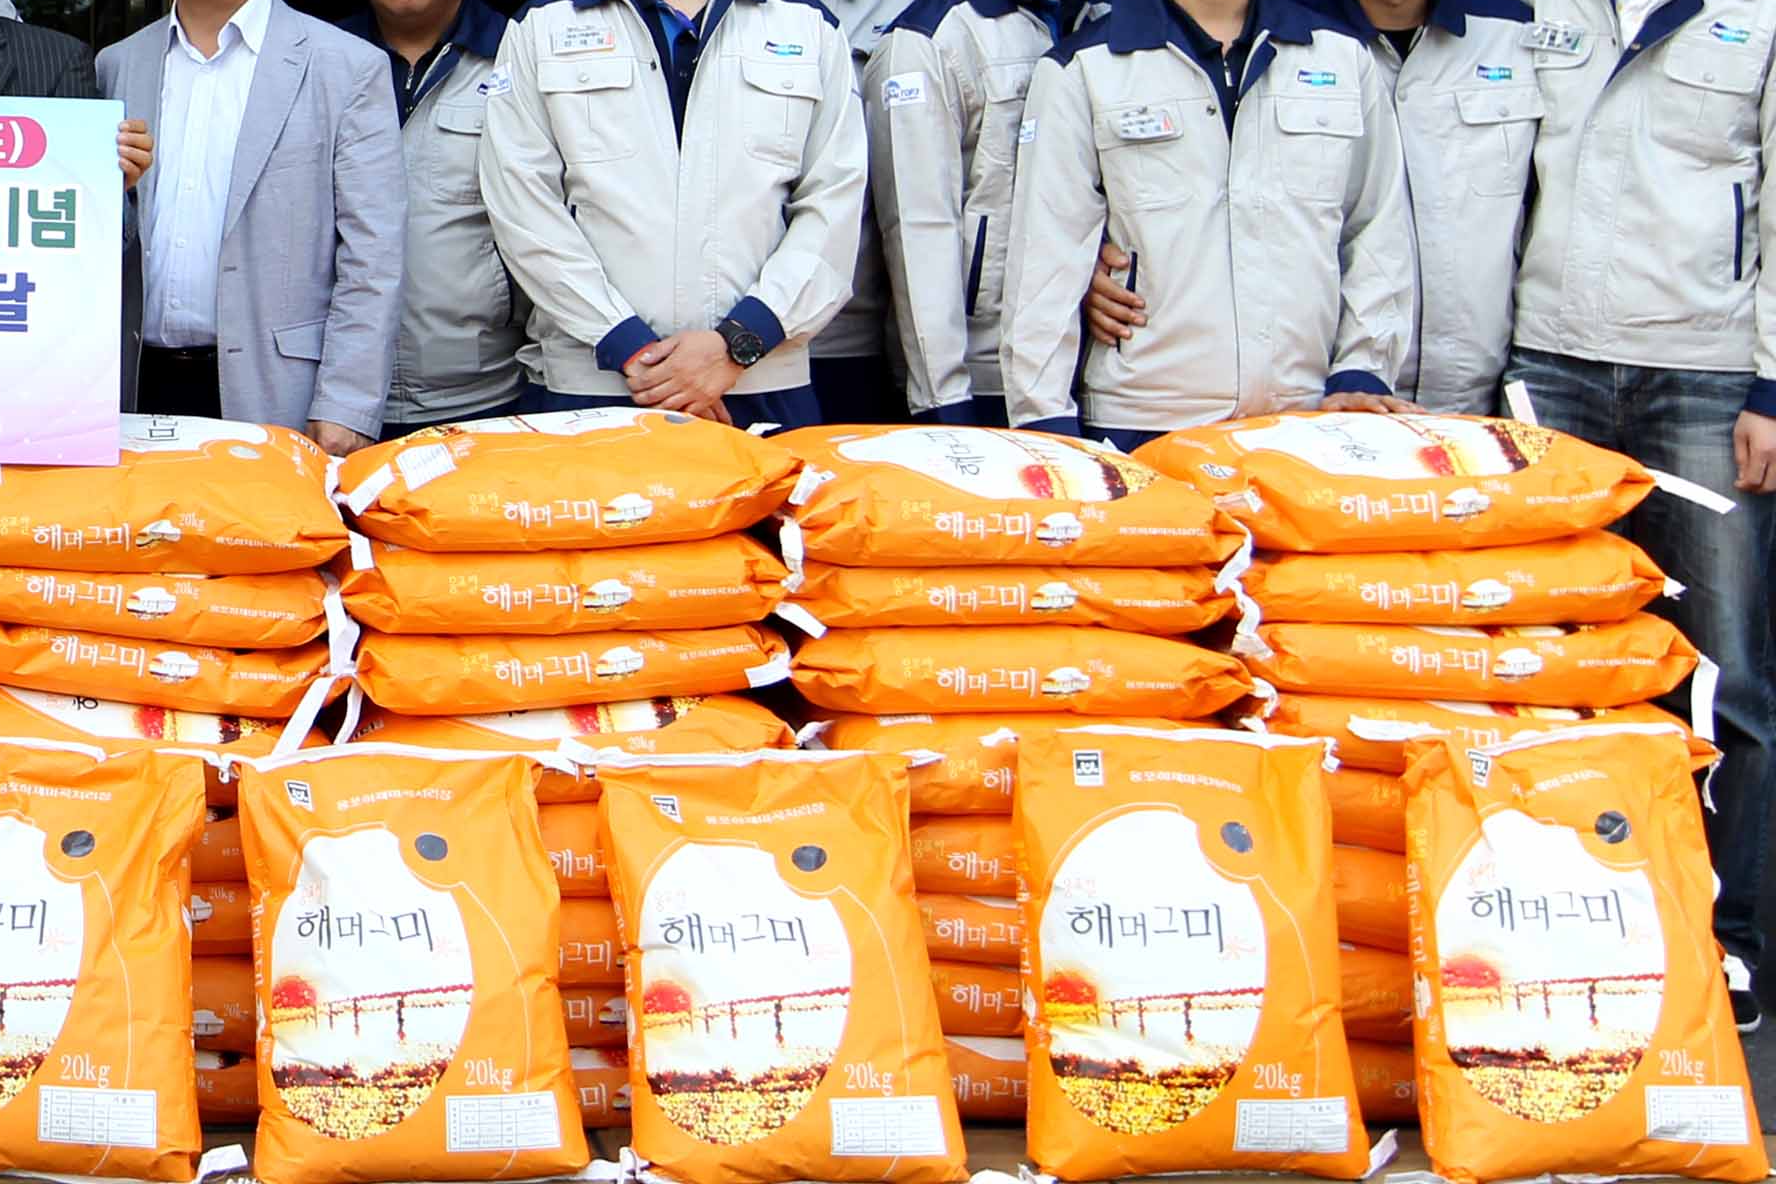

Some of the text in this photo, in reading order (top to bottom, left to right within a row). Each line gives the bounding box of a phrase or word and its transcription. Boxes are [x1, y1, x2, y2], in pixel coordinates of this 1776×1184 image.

[504, 501, 600, 531] 해머그미
[1340, 490, 1439, 522] 해머그미
[33, 523, 129, 552] 해머그미
[934, 512, 1031, 544] 해머그미
[26, 576, 123, 615] 해머그미
[482, 583, 580, 612] 해머그미
[929, 582, 1025, 613] 해머그미
[1361, 581, 1458, 611] 해머그미
[50, 637, 145, 677] 해머그미
[495, 652, 592, 686] 해머그미
[1392, 646, 1488, 679] 해머그미
[935, 666, 1037, 696] 해머그미
[296, 906, 434, 951] 해머그미
[1065, 903, 1224, 953] 해머그미
[1466, 887, 1626, 938] 해머그미
[659, 913, 809, 956] 해머그미
[951, 983, 1020, 1014] 해머그
[60, 1054, 110, 1087] 20kg
[464, 1061, 512, 1092] 20kg
[844, 1064, 895, 1096] 20kg
[1253, 1064, 1303, 1096] 20kg
[1659, 1051, 1704, 1084] 20kg
